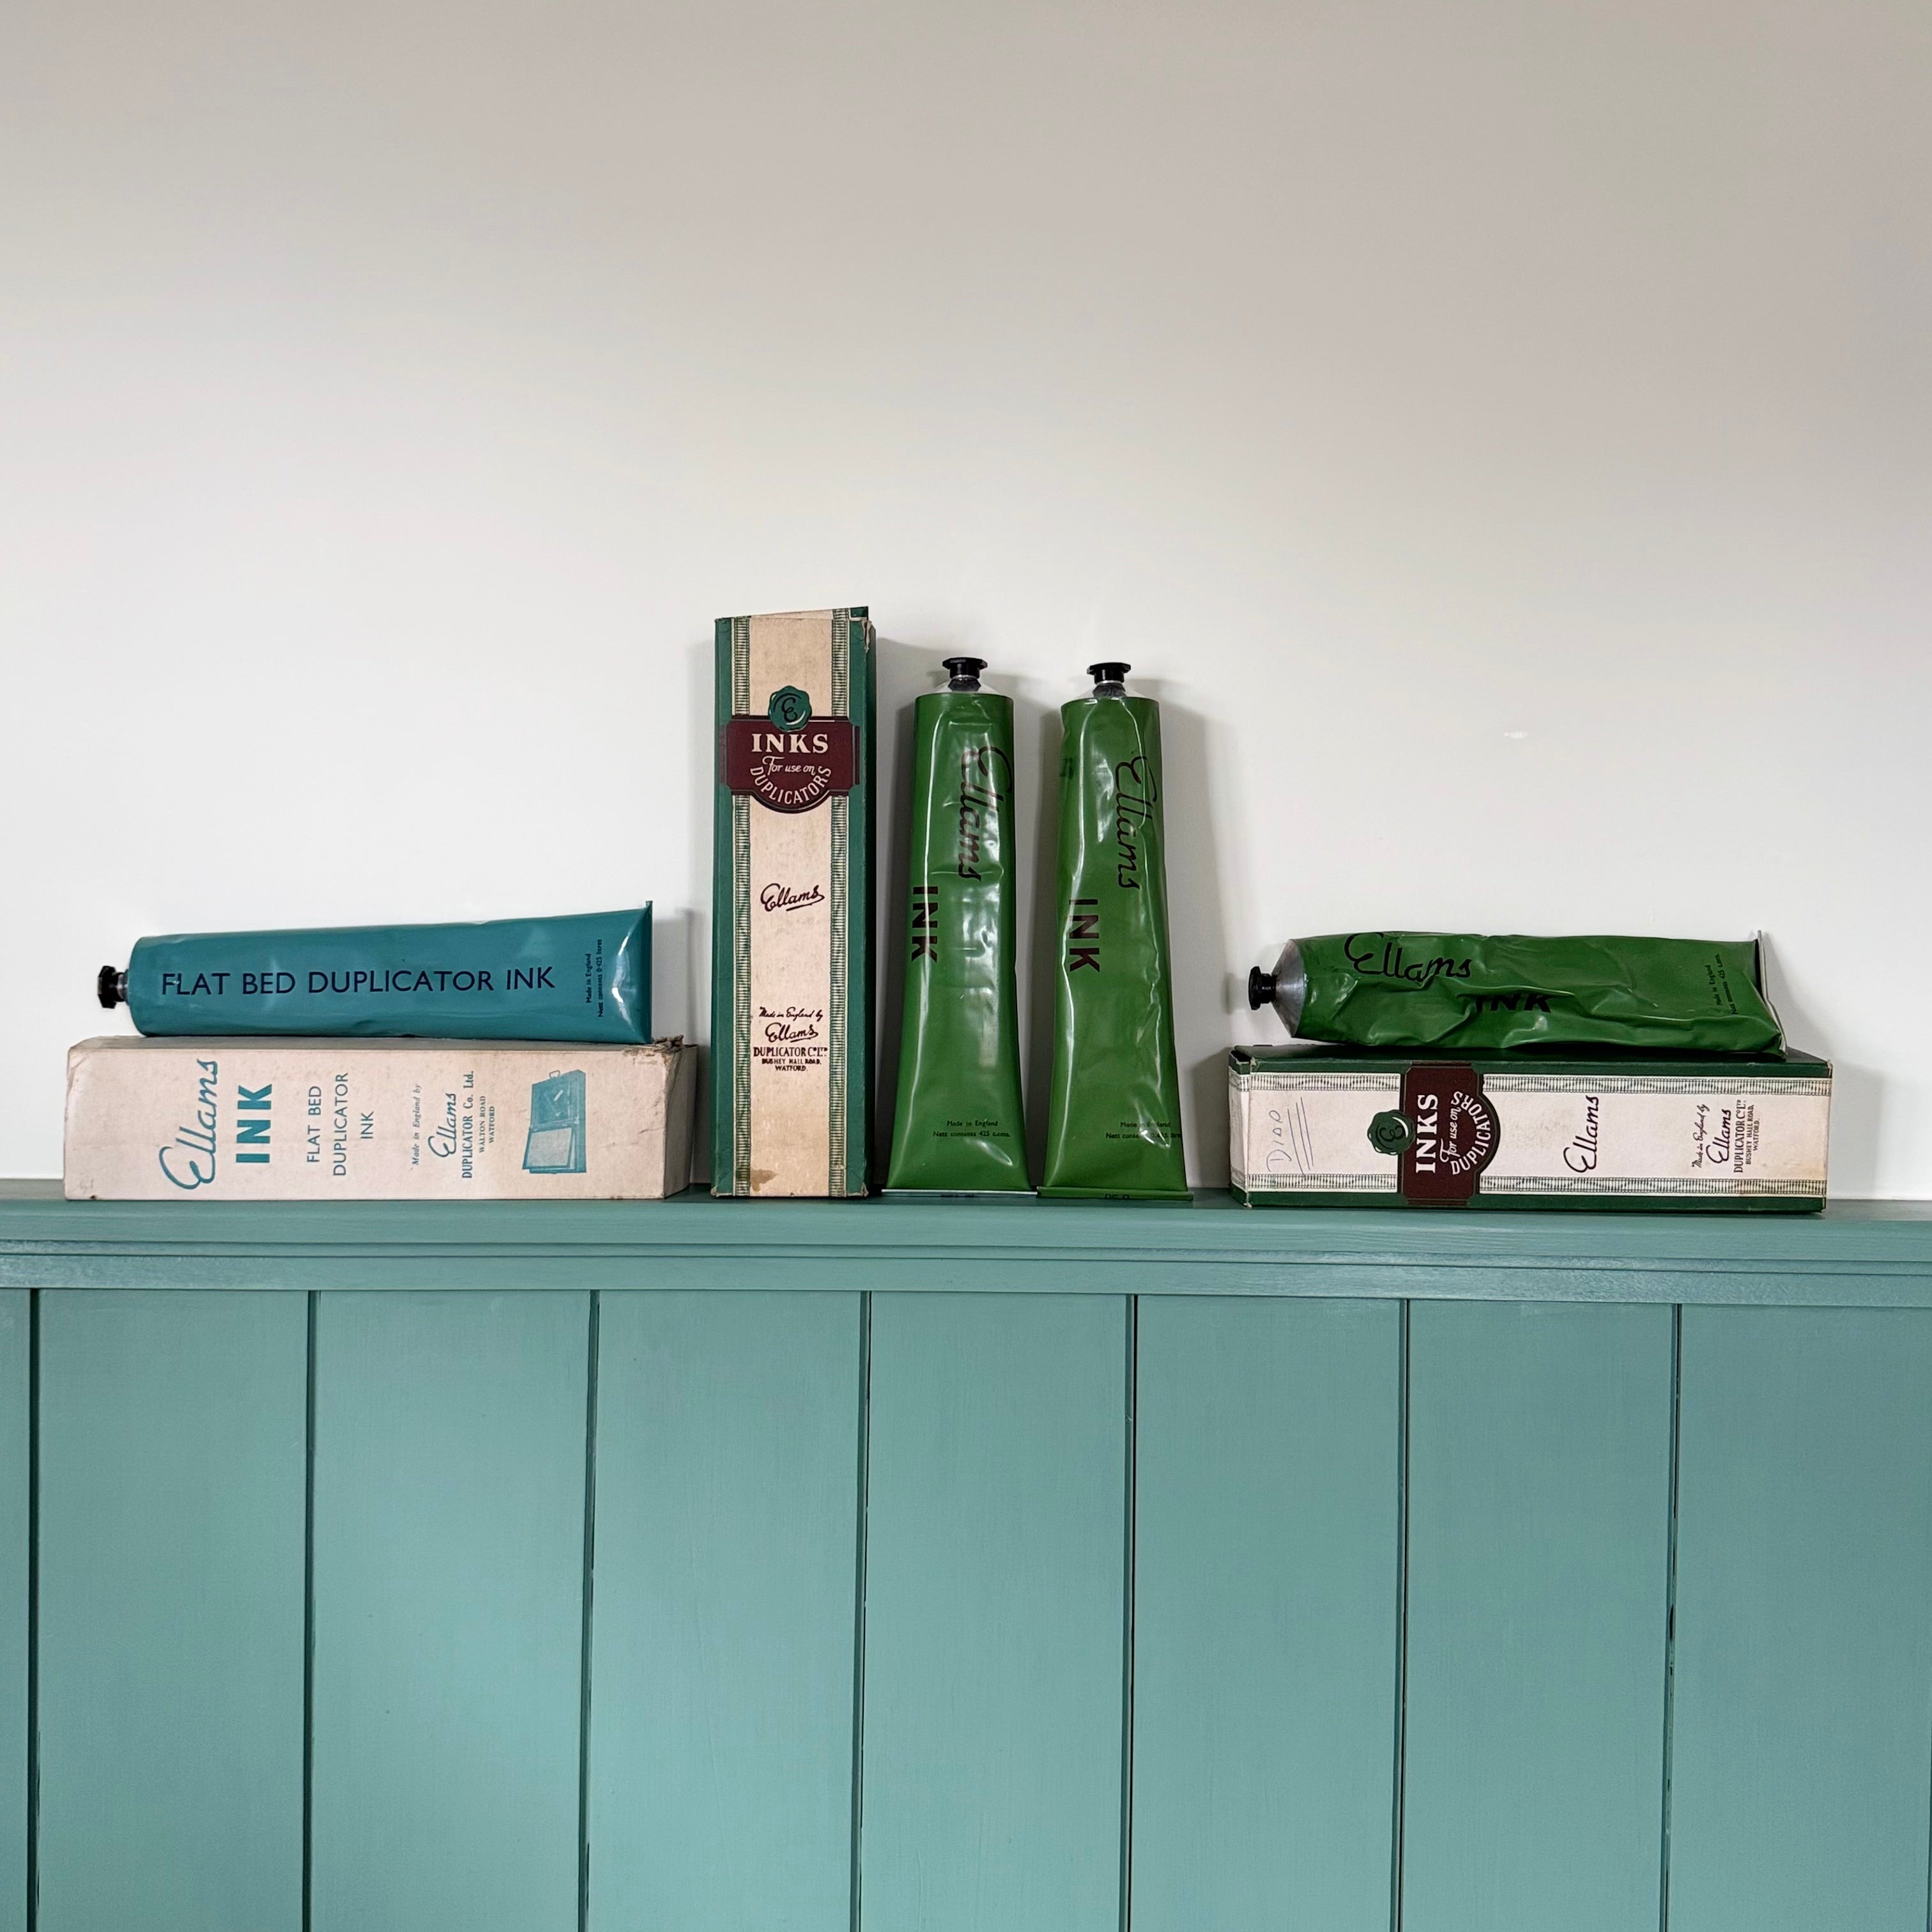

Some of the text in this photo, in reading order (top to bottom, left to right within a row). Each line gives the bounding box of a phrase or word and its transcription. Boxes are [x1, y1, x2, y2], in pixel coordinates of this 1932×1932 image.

[751, 733, 829, 753] INKS
[750, 766, 831, 804] DUPLICATORS
[762, 756, 785, 776] For
[803, 767, 816, 776] on
[958, 746, 1012, 882] Ellams
[1114, 756, 1158, 889] Ellams
[760, 883, 825, 912] Ellams
[911, 886, 939, 962] INK
[1070, 899, 1100, 972] INK
[585, 953, 593, 977] England
[1344, 932, 1472, 982] Ellams
[1705, 965, 1716, 985] England
[162, 967, 556, 995] FLAT BED DUPLICATOR INK
[759, 1006, 776, 1018] Made
[786, 1007, 815, 1021] England
[816, 1009, 824, 1022] by
[1464, 993, 1551, 1013] INK
[765, 1022, 818, 1043] Ellams
[753, 1047, 806, 1057] DUPLICATOR
[413, 1084, 422, 1093] by
[159, 1058, 218, 1190] Ellams
[236, 1084, 272, 1163] INK
[307, 1086, 321, 1162] FLAT BED
[333, 1072, 349, 1176] DUPLICATOR
[360, 1110, 374, 1139] INK
[413, 1096, 422, 1128] England
[428, 1092, 457, 1158] Ellams
[462, 1071, 474, 1178] DUPLICATOR Co. Ltd.
[1692, 1112, 1707, 1141] England
[1697, 1104, 1710, 1113] by
[1416, 1094, 1438, 1174] INKS
[1439, 1138, 1460, 1163] For
[1450, 1107, 1461, 1121] on
[1451, 1091, 1491, 1175] DUPLICATORS
[1563, 1095, 1598, 1173] Ellams
[1706, 1108, 1731, 1163] Ellams
[1733, 1120, 1745, 1173] DUPLICATOR
[411, 1143, 420, 1165] Made
[1692, 1151, 1703, 1169] Made
